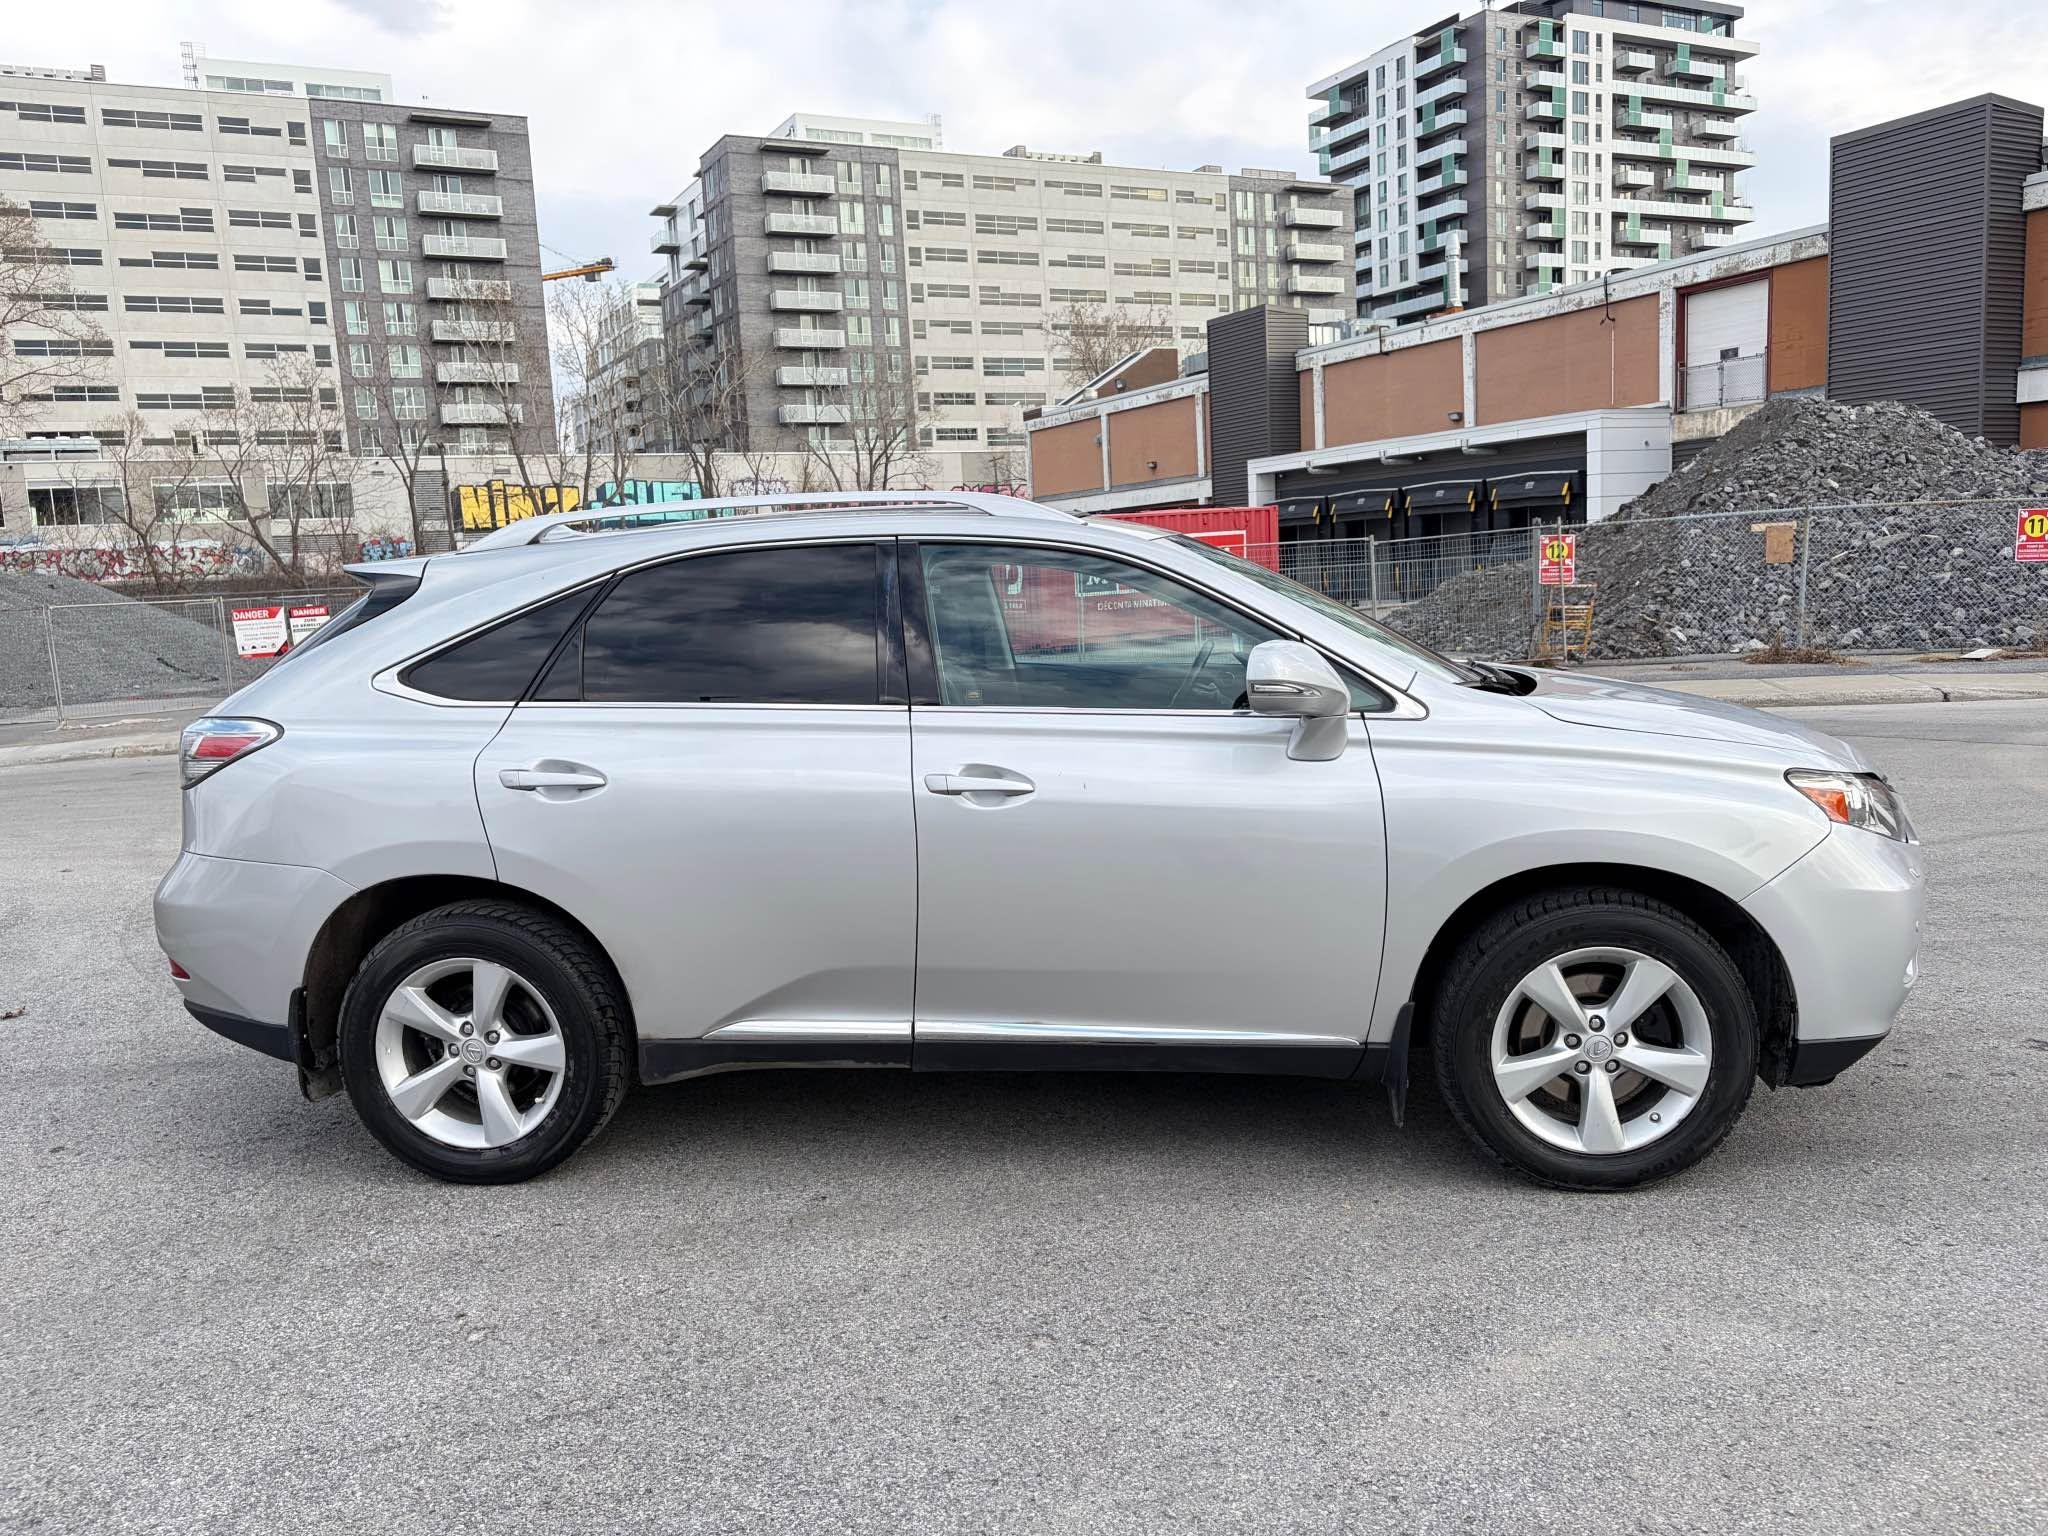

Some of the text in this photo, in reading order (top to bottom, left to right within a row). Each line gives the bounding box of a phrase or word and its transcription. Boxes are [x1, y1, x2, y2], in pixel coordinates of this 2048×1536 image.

[2029, 518, 2044, 534] 11
[1548, 543, 1565, 559] 12
[232, 610, 269, 620] DANGER
[293, 608, 325, 616] DANGER
